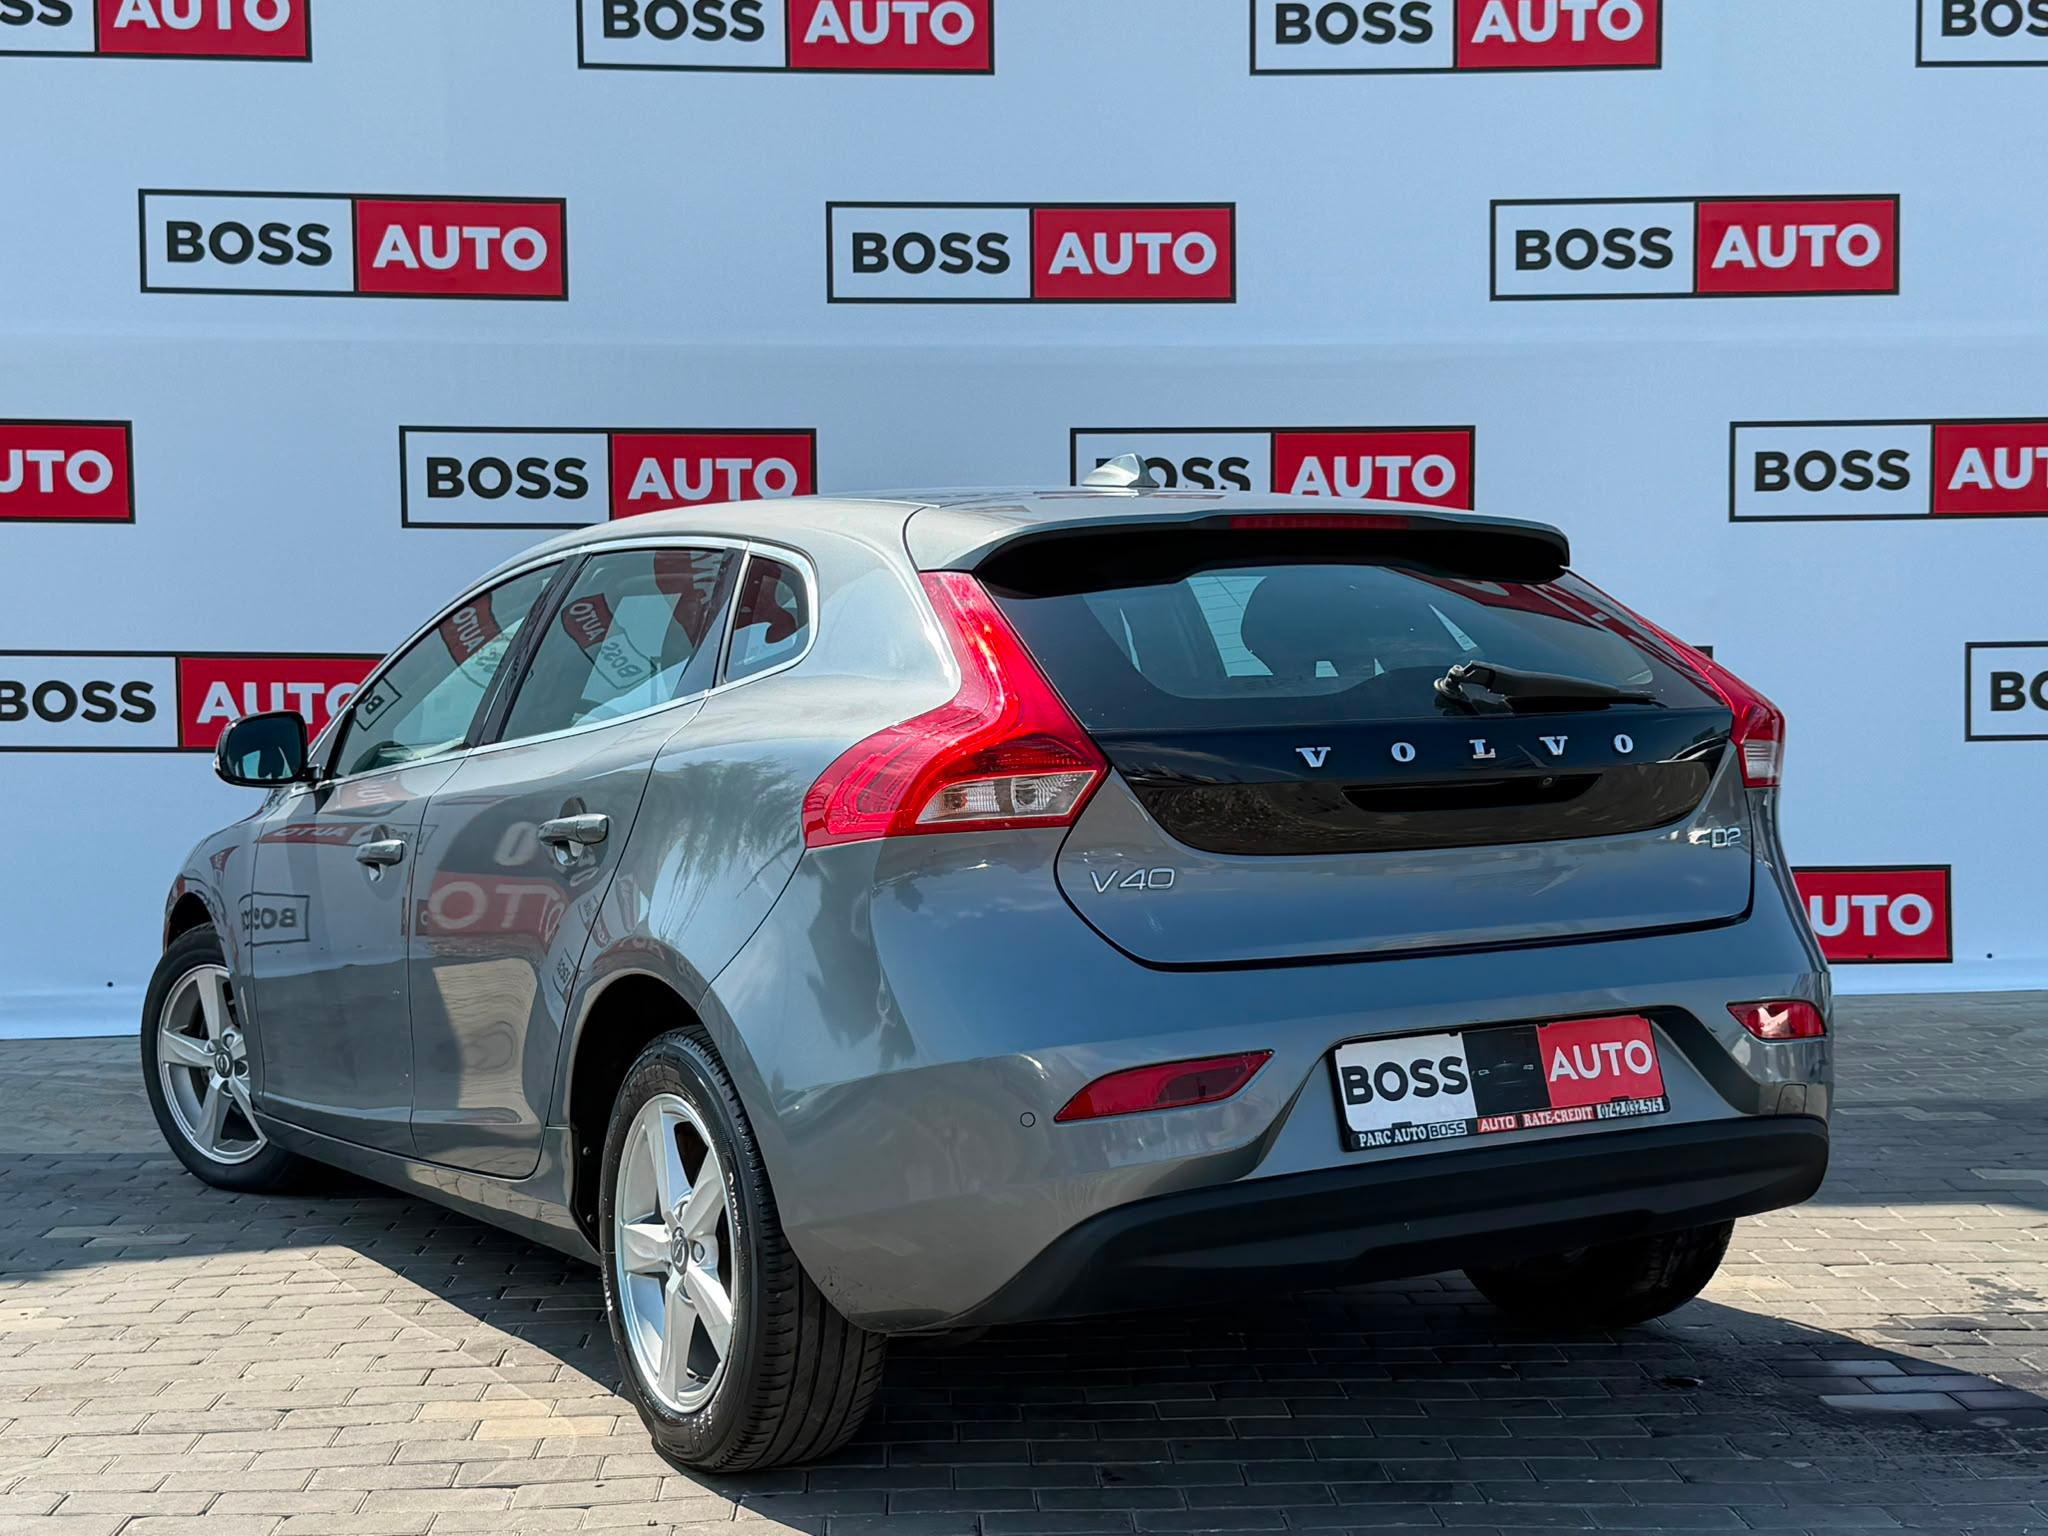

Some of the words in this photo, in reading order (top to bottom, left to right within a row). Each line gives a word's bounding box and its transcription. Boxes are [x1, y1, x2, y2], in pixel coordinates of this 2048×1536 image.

[113, 0, 291, 32] AUTO
[603, 0, 765, 42] BOSS
[803, 0, 975, 45] AUTO
[1275, 2, 1433, 45] BOSS
[1471, 0, 1644, 43] AUTO
[166, 221, 332, 266] BOSS
[372, 225, 548, 271] AUTO
[852, 232, 1010, 274] BOSS
[1048, 232, 1217, 275] AUTO
[1515, 228, 1673, 270] BOSS
[1711, 224, 1881, 268] AUTO
[426, 457, 589, 500] BOSS
[629, 458, 798, 499] AUTO
[1291, 455, 1456, 497] AUTO
[1754, 450, 1911, 492] BOSS
[0, 681, 156, 723] BOSS
[1296, 733, 1634, 768] VOLVO
[1711, 828, 1742, 848] D2
[1091, 868, 1176, 894] V40
[1809, 893, 1934, 937] UTO
[1341, 1056, 1469, 1105] BOSS
[1549, 1040, 1653, 1083] AUTO
[1358, 1130, 1392, 1147] PARC
[1394, 1126, 1427, 1143] AUTO
[1429, 1122, 1466, 1138] BOSS
[1480, 1115, 1516, 1131] AUTO
